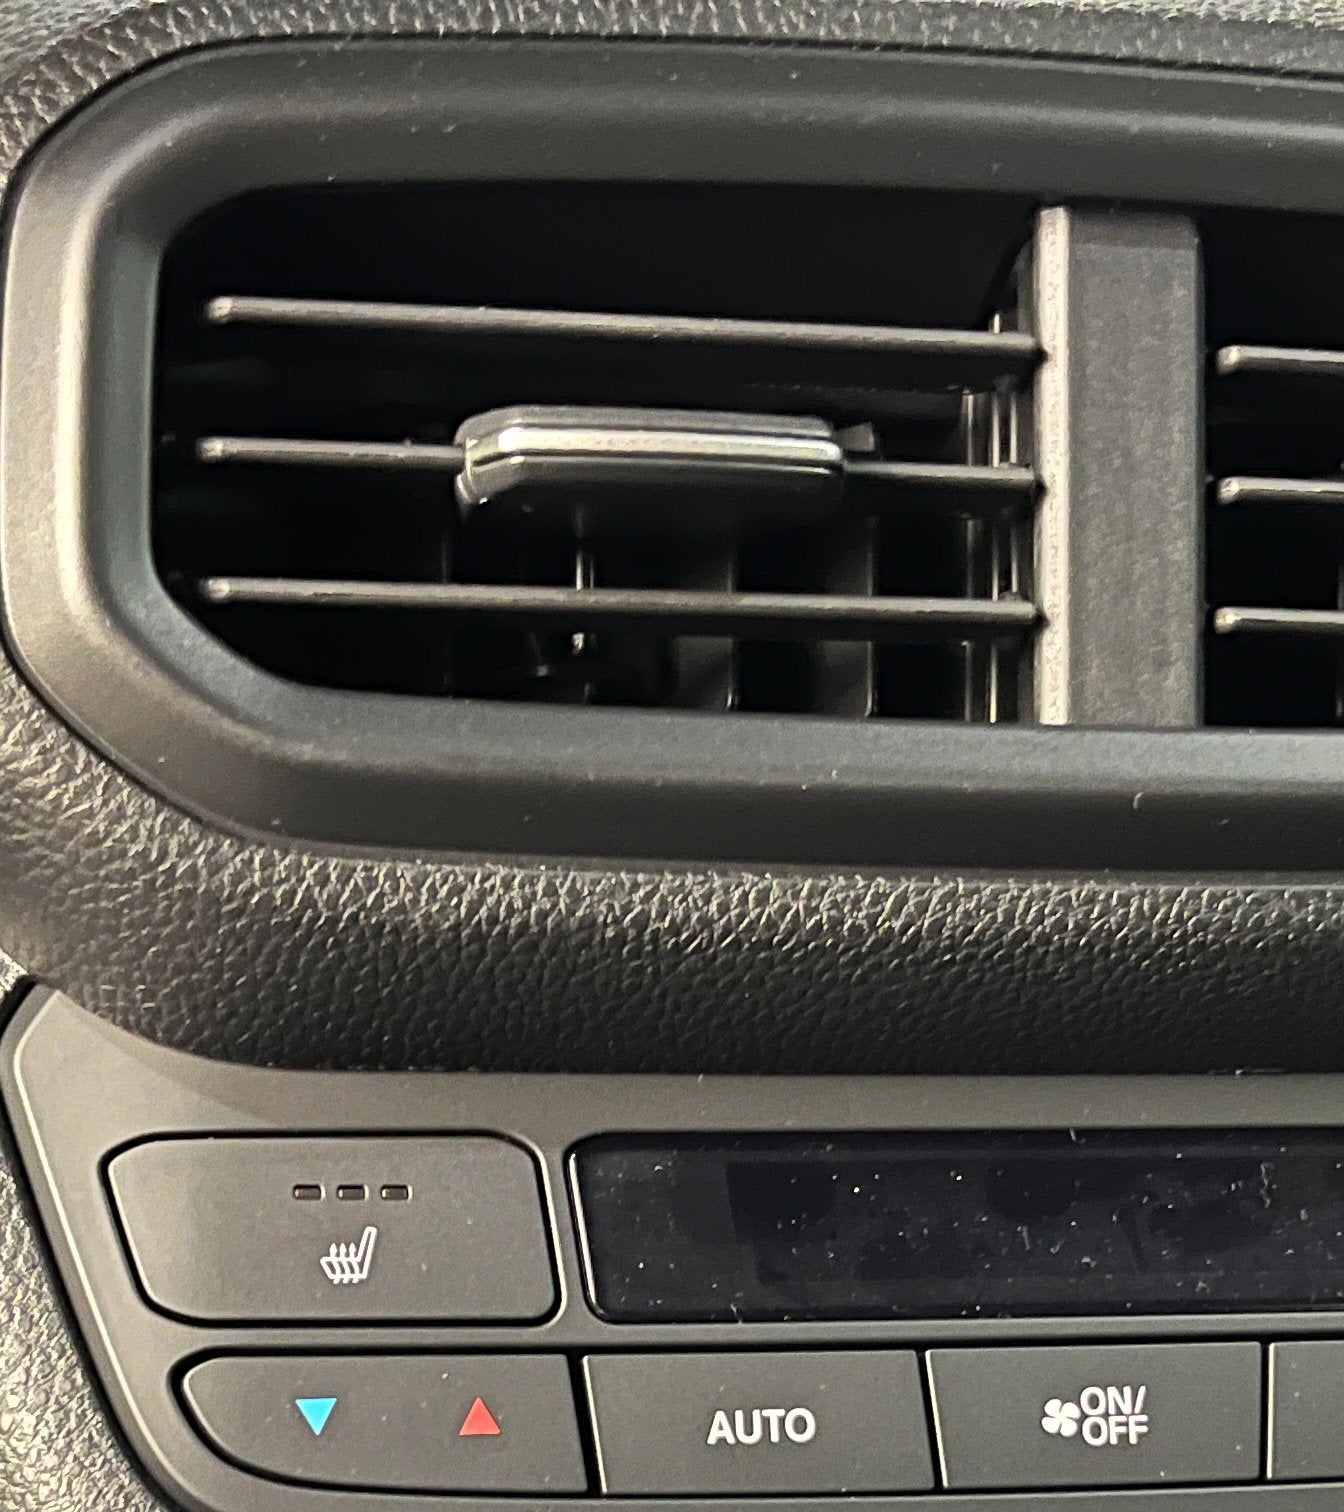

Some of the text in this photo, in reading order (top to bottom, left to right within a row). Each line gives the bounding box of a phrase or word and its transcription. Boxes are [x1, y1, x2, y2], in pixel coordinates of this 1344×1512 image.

[1080, 1386, 1146, 1415] ON/
[707, 1407, 816, 1445] AUTO
[1081, 1415, 1149, 1447] OFF
